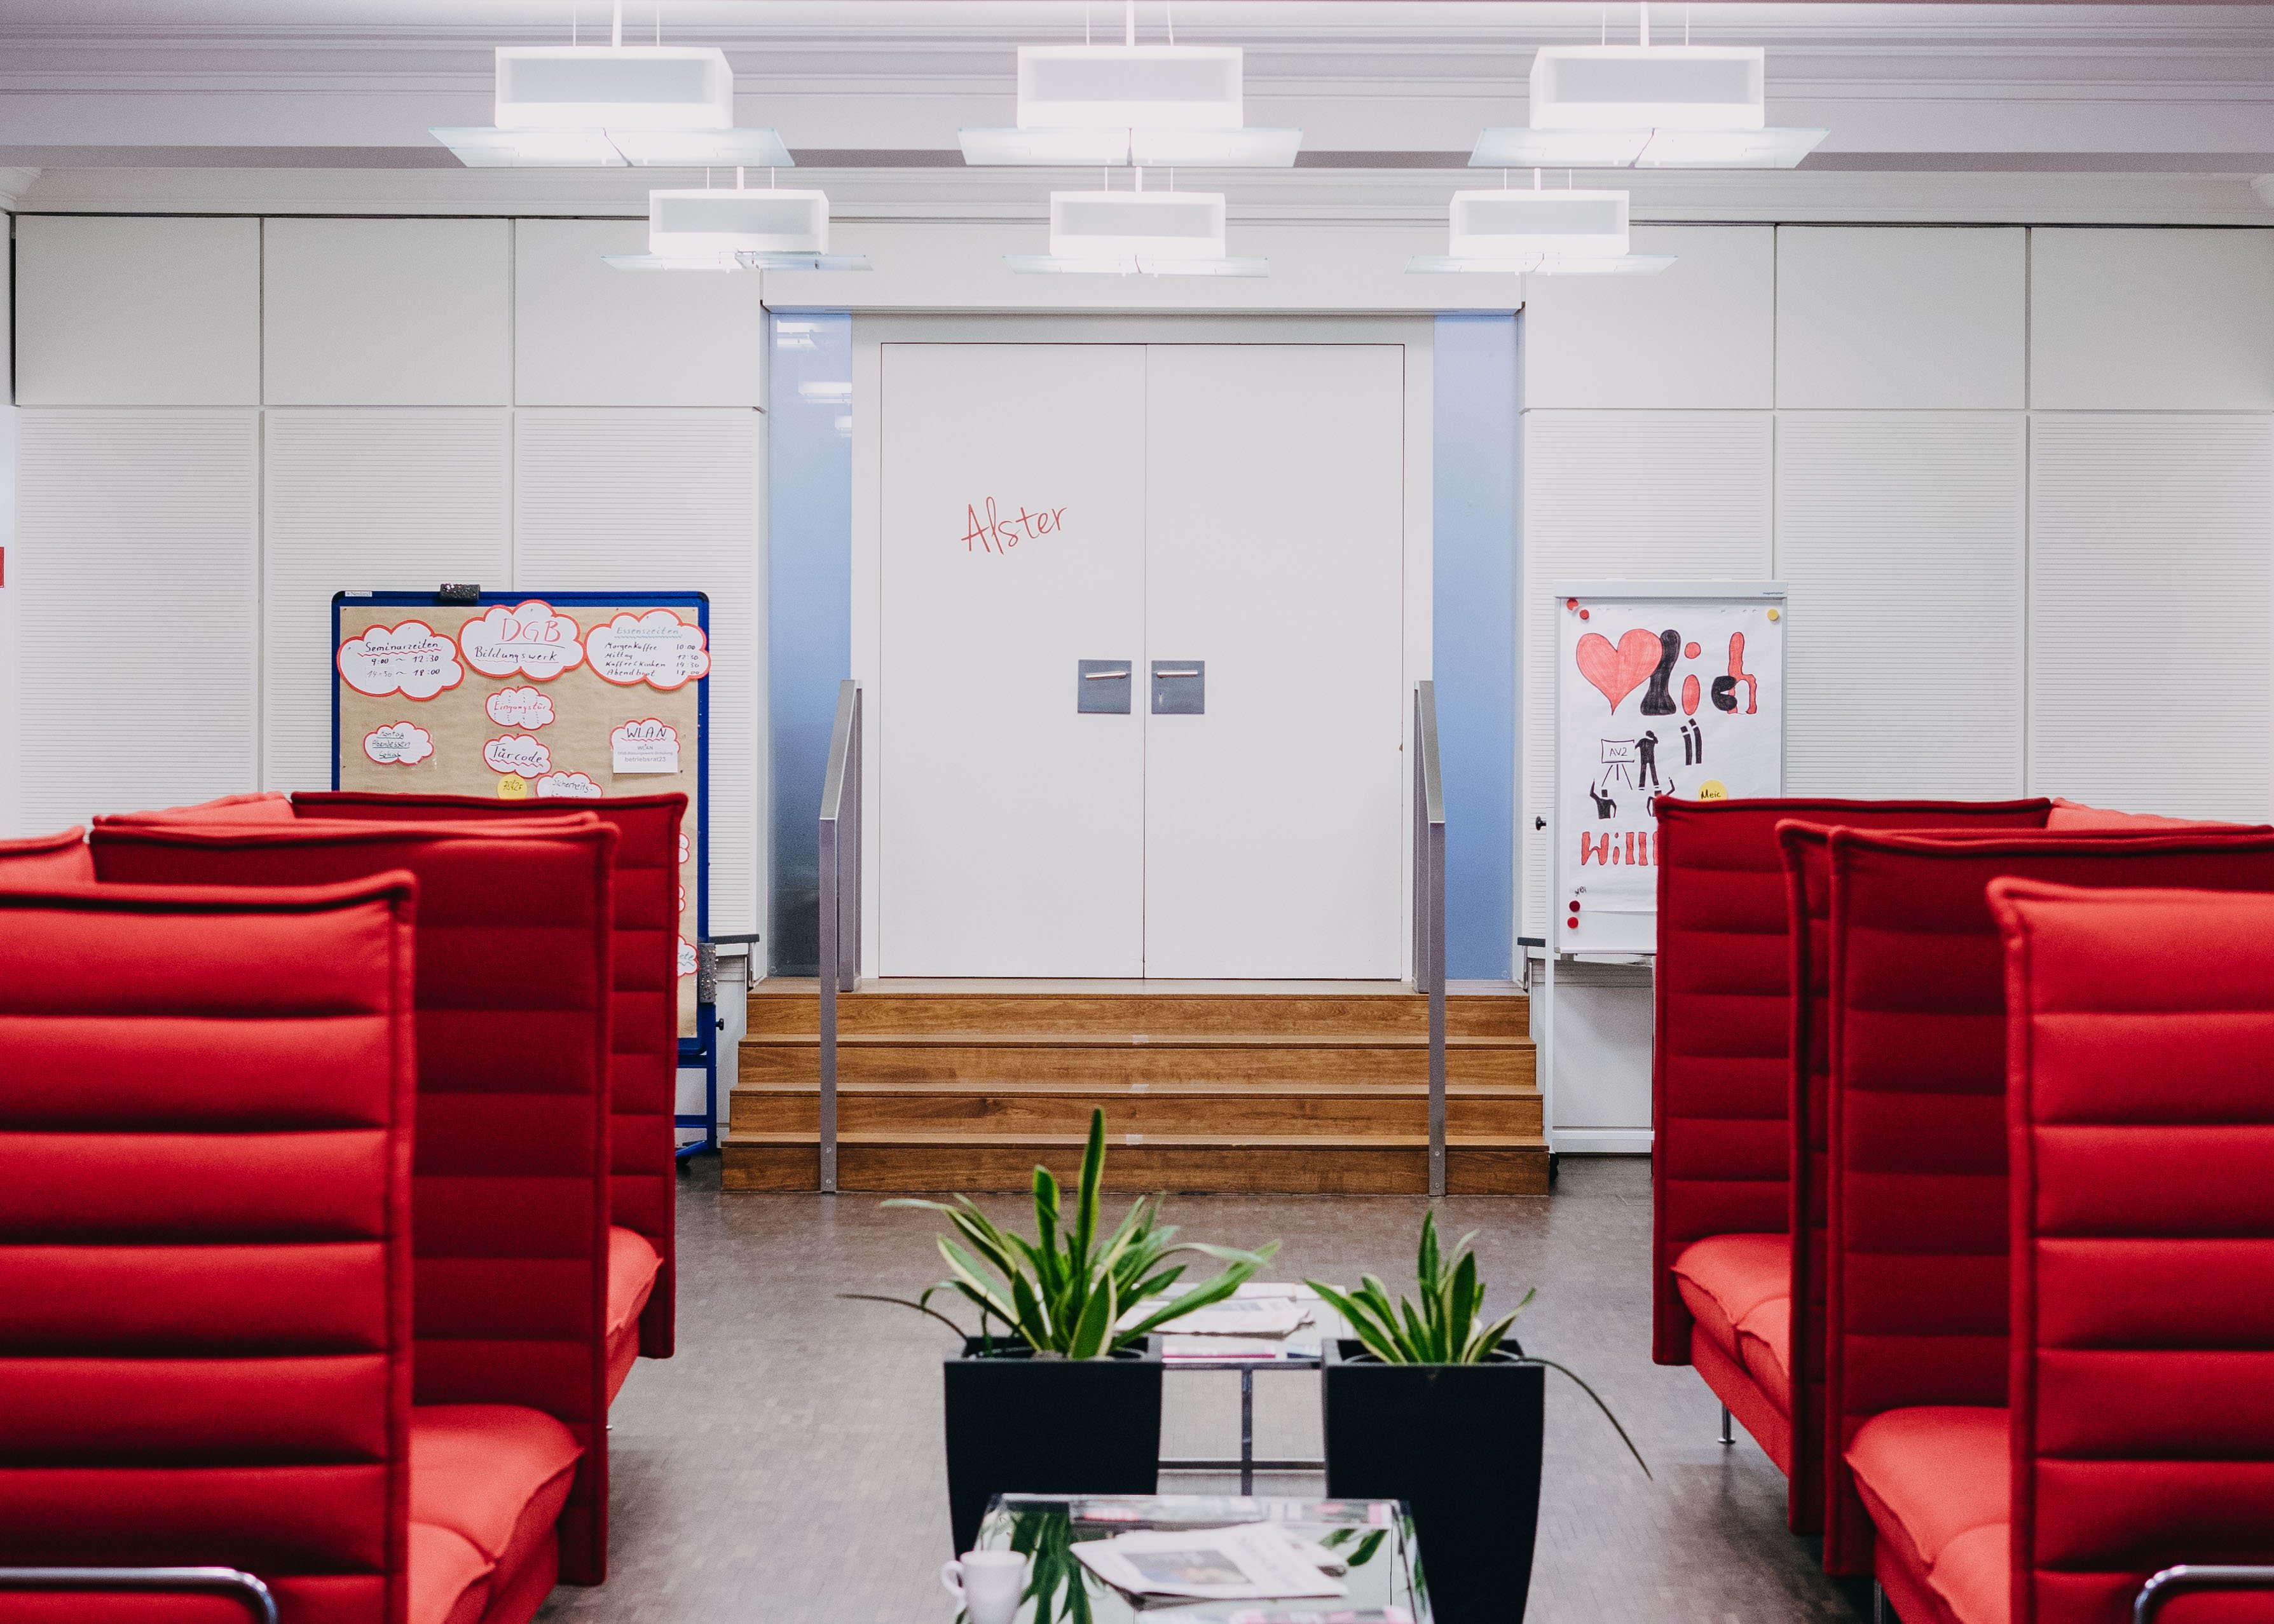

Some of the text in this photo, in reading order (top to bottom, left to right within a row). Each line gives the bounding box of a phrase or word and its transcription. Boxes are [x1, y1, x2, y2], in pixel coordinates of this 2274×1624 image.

[961, 496, 1068, 556] Alster
[501, 618, 561, 642] DGB
[364, 638, 438, 653] Seminarzeiten
[474, 645, 558, 663] Bildungswerk
[371, 657, 389, 666] 9:00
[413, 669, 441, 677] 18:00
[494, 700, 547, 714] Eingangstür
[627, 727, 667, 738] WLAN
[490, 743, 542, 763] Türcode
[1608, 747, 1628, 757] AV2
